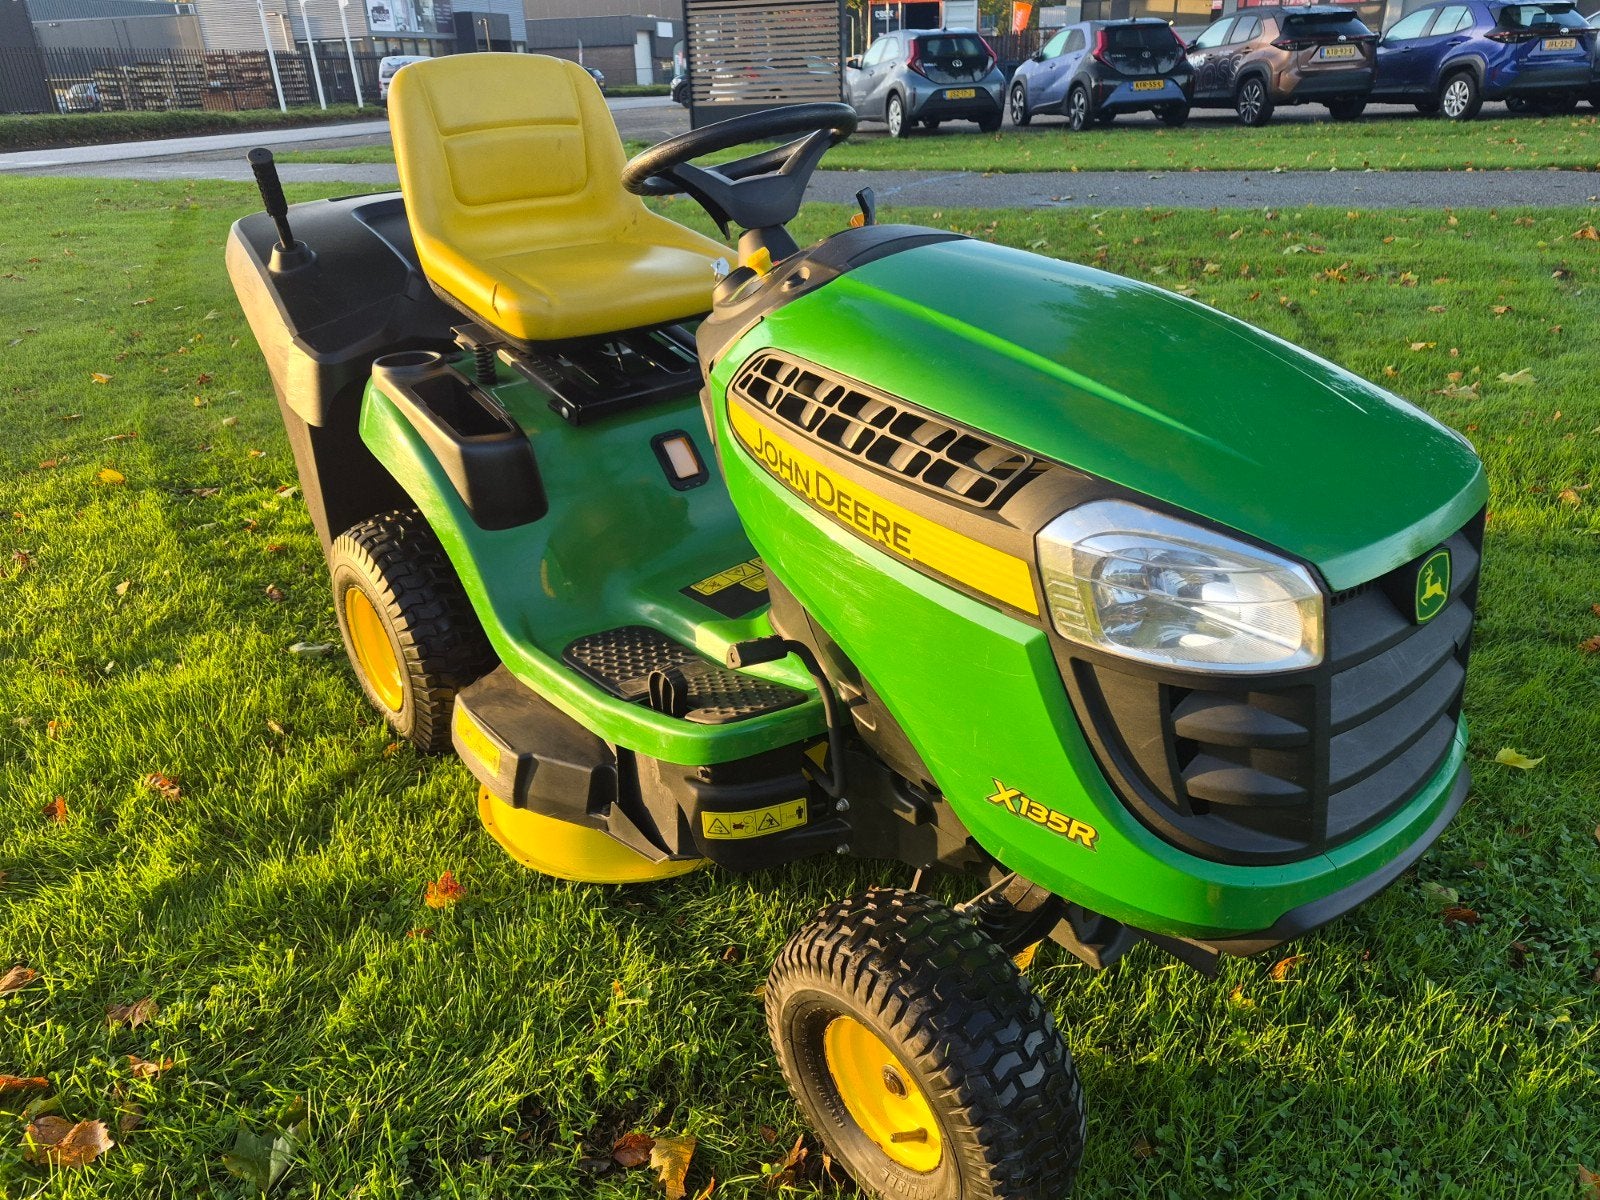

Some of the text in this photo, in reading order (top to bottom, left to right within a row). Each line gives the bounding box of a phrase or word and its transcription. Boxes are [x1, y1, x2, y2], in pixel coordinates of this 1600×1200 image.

[754, 428, 911, 554] JOHN DEERE
[986, 777, 1098, 850] X135R
